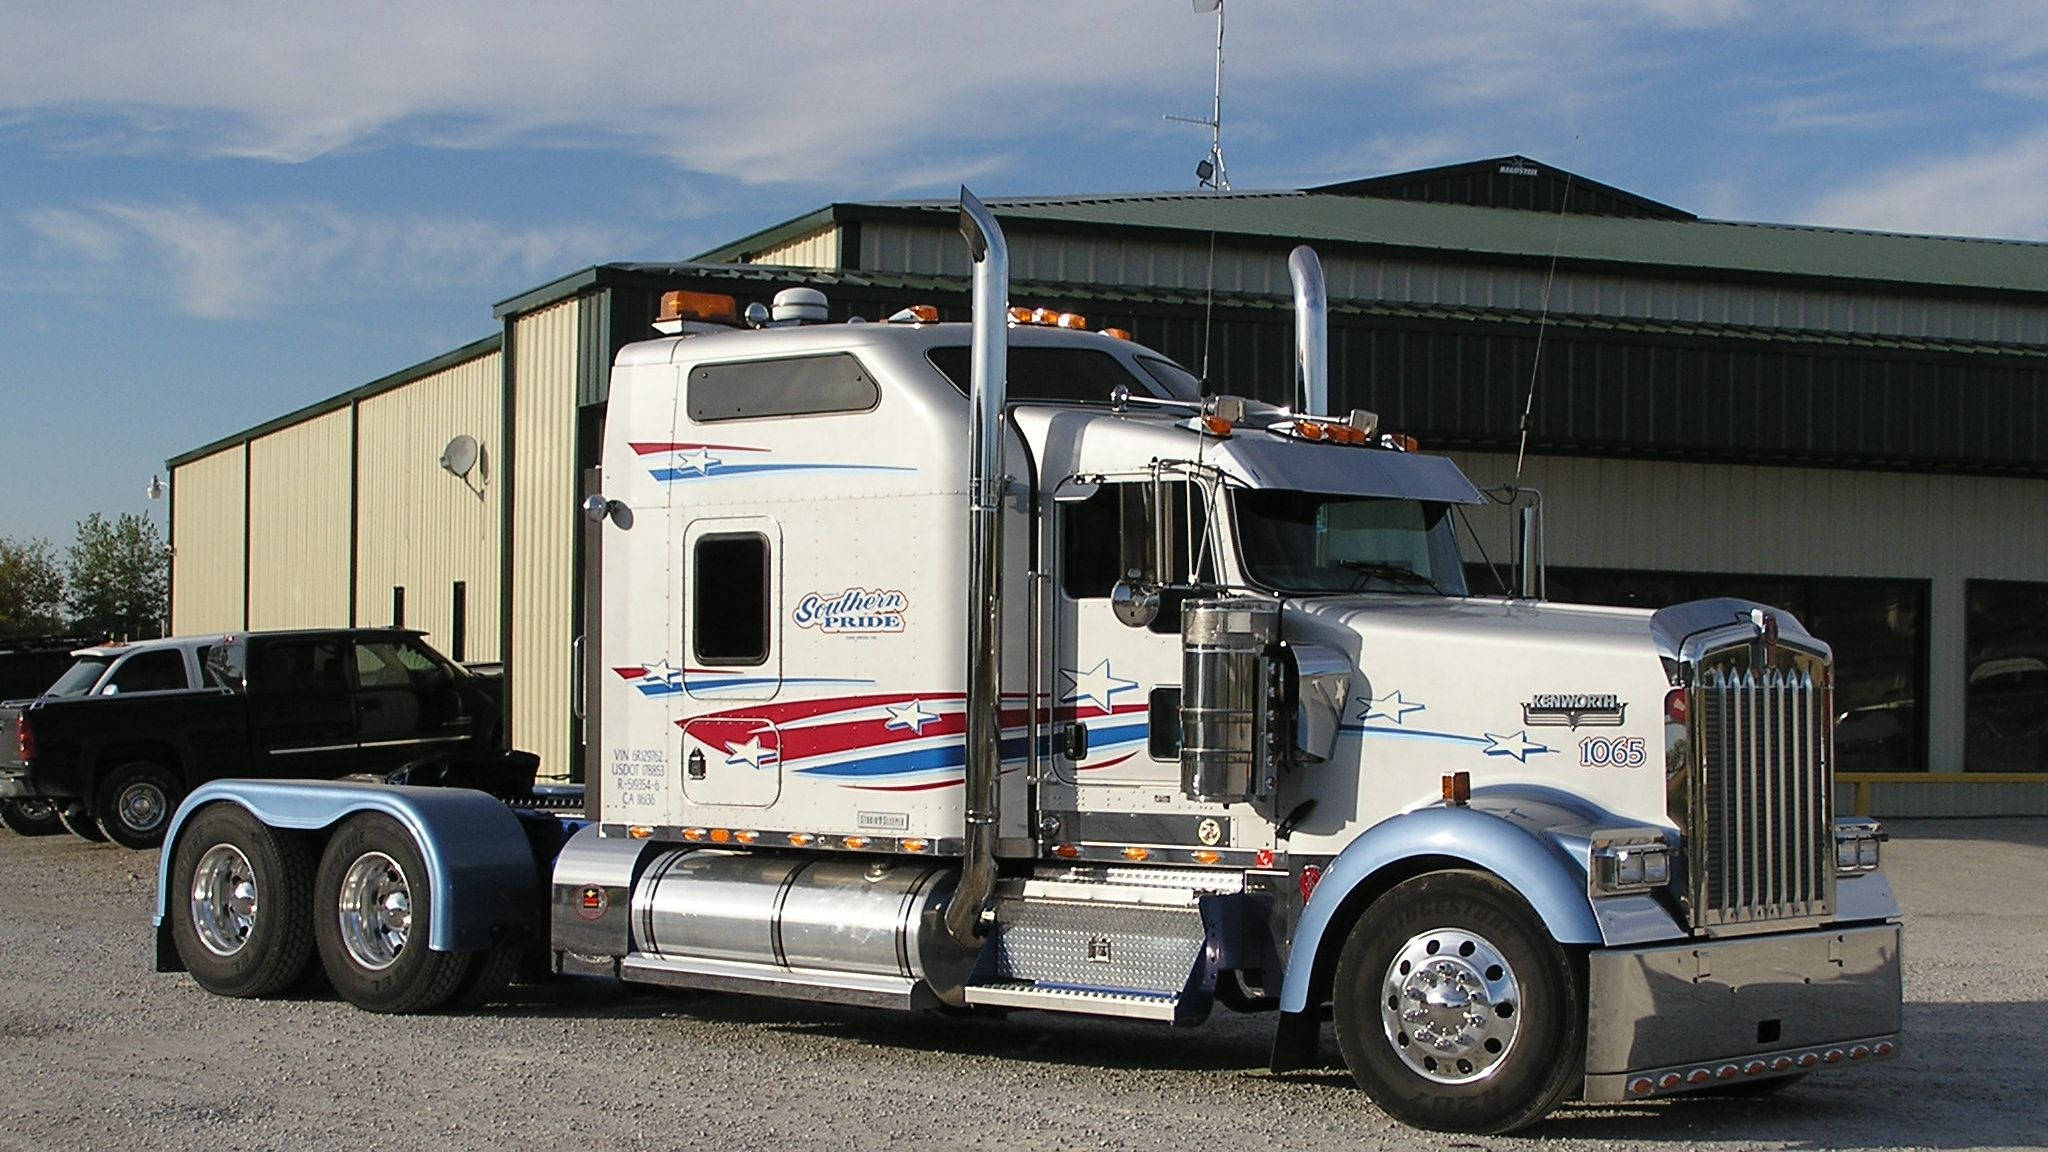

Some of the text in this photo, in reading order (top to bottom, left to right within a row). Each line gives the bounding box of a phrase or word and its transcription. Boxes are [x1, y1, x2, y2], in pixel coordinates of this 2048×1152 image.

[795, 591, 901, 622] Southern
[824, 616, 900, 628] PRIDE
[1530, 693, 1618, 709] KENWORTH
[613, 749, 630, 761] VIN
[1579, 737, 1645, 767] 1065
[611, 763, 639, 776] USDOT
[622, 792, 635, 805] CA
